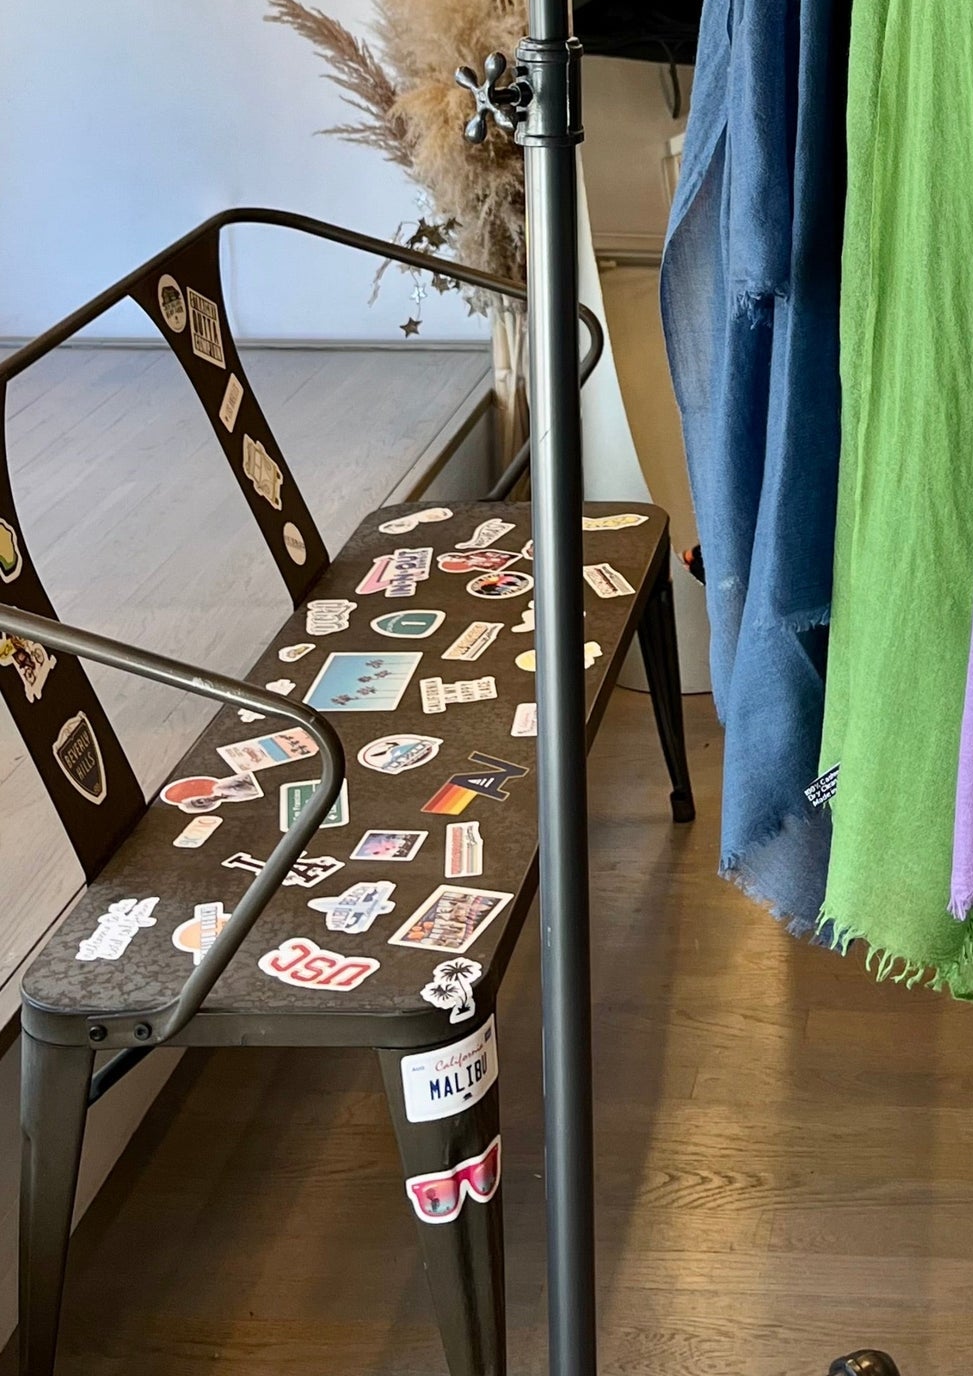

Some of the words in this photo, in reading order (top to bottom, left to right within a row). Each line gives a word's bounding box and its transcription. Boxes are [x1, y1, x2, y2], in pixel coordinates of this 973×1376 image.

[64, 730, 91, 770] BEVERLY
[75, 751, 96, 781] HILLS
[270, 943, 372, 987] USC
[429, 1051, 488, 1101] MALIBU
[434, 1043, 484, 1073] California
